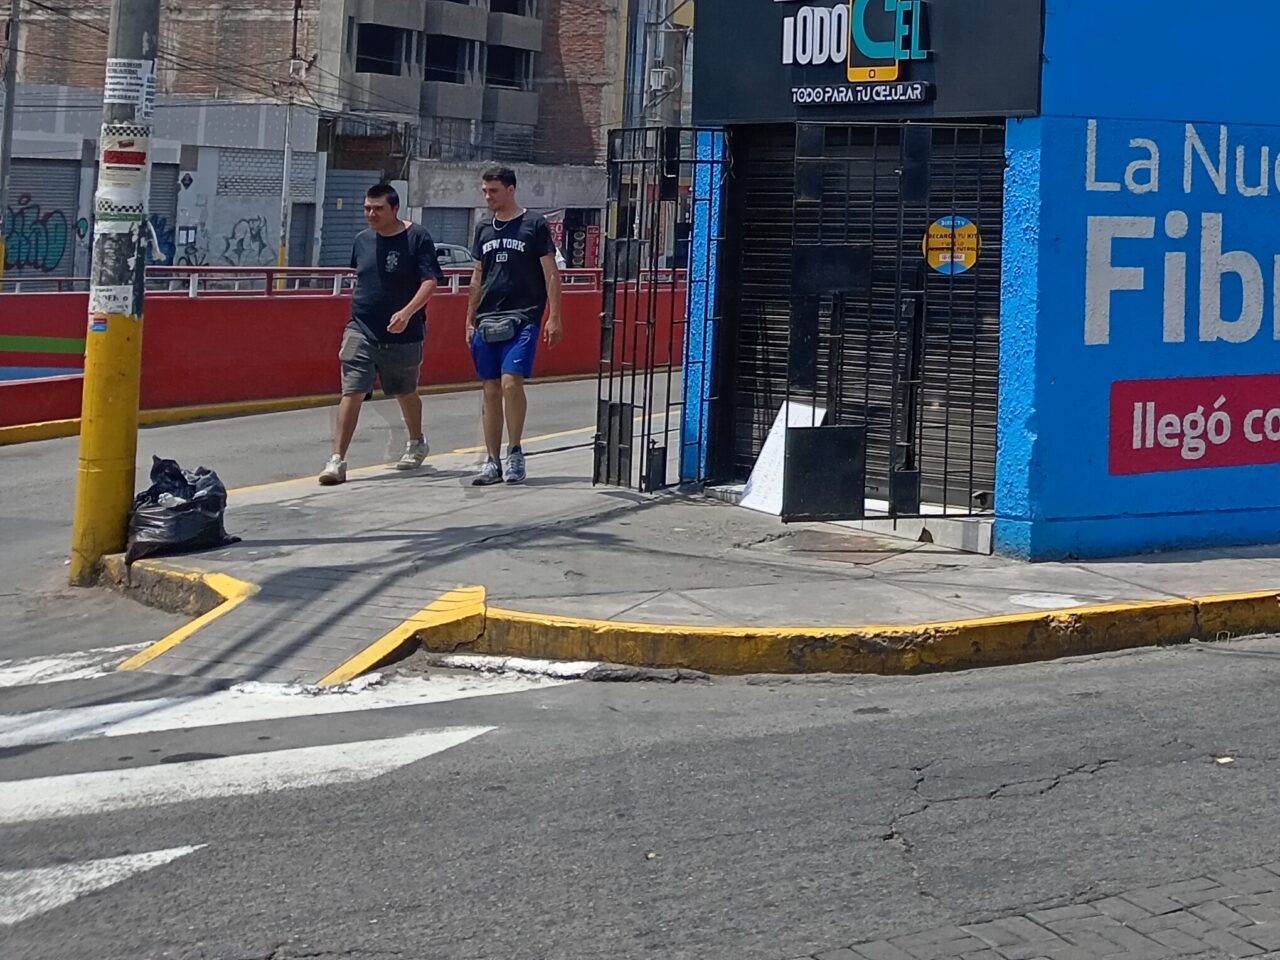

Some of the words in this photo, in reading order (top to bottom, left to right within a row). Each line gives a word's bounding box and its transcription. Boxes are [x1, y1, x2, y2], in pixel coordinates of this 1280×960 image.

[791, 87, 823, 103] TODO
[824, 87, 853, 102] PARA
[856, 86, 870, 101] TU
[872, 84, 922, 101] CELULAR
[1085, 118, 1159, 195] La
[502, 238, 526, 253] YORK
[1131, 395, 1232, 460] llegó
